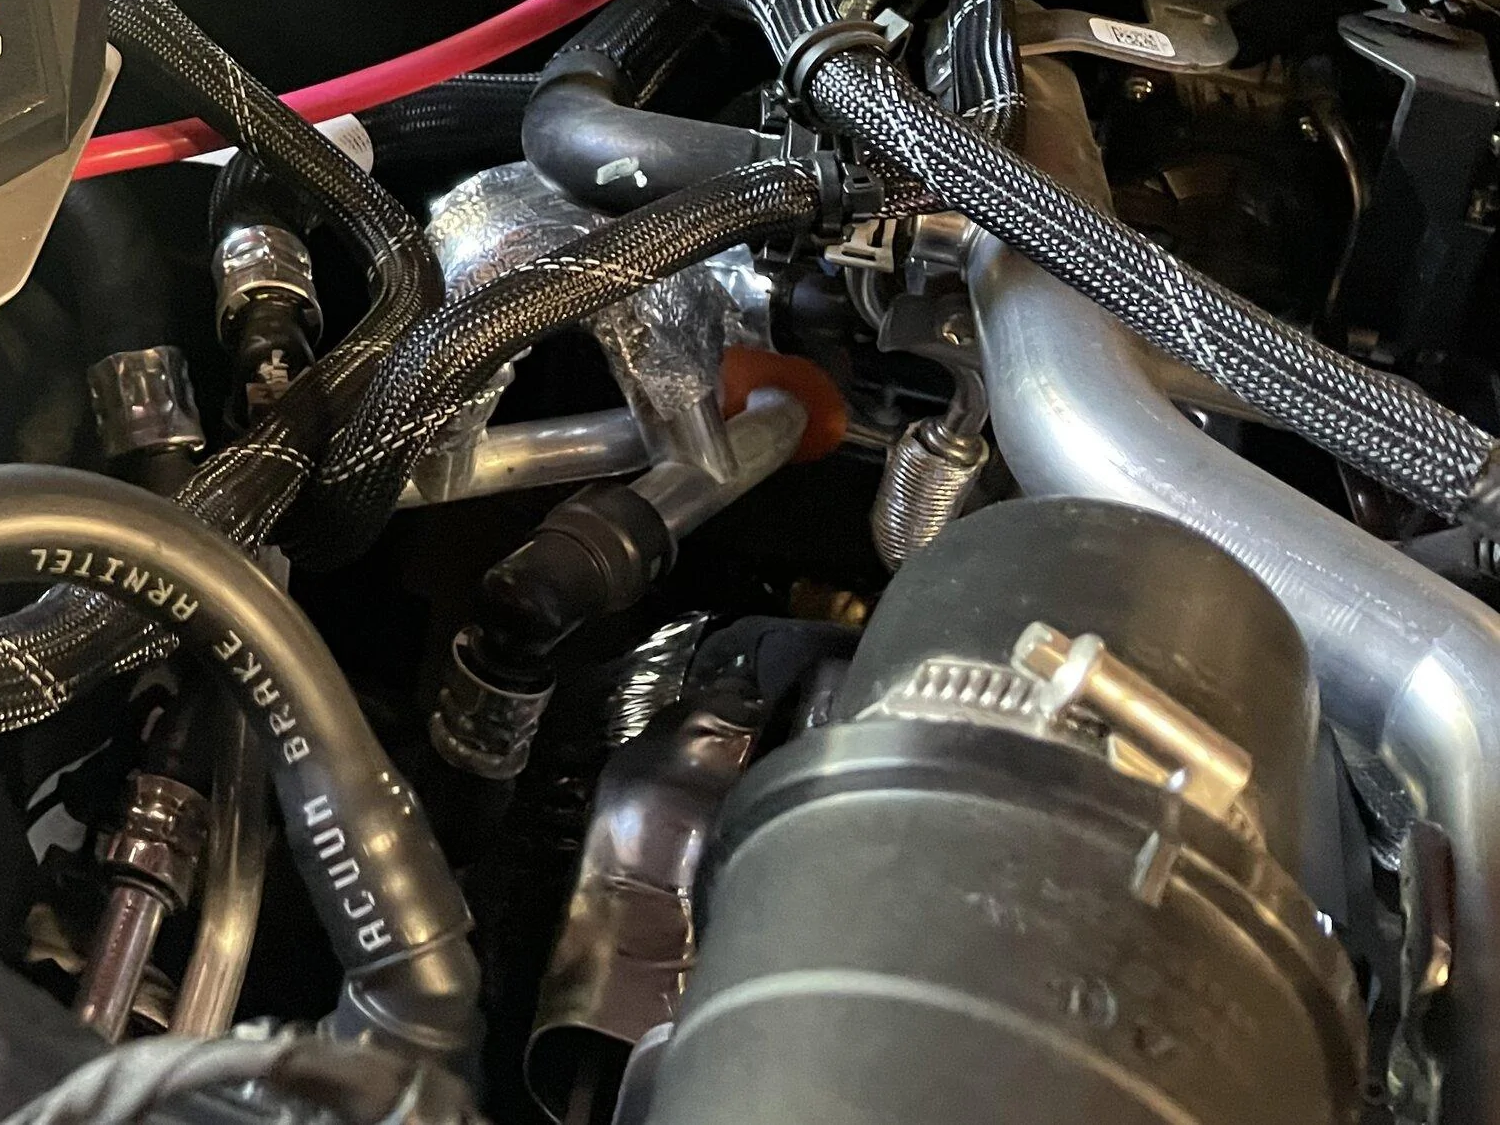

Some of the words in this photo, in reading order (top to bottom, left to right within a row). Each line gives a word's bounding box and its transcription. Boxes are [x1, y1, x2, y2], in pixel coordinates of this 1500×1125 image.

[30, 548, 199, 622] ARNITEL
[213, 629, 310, 764] BRAKE
[303, 794, 392, 952] ACUUM
